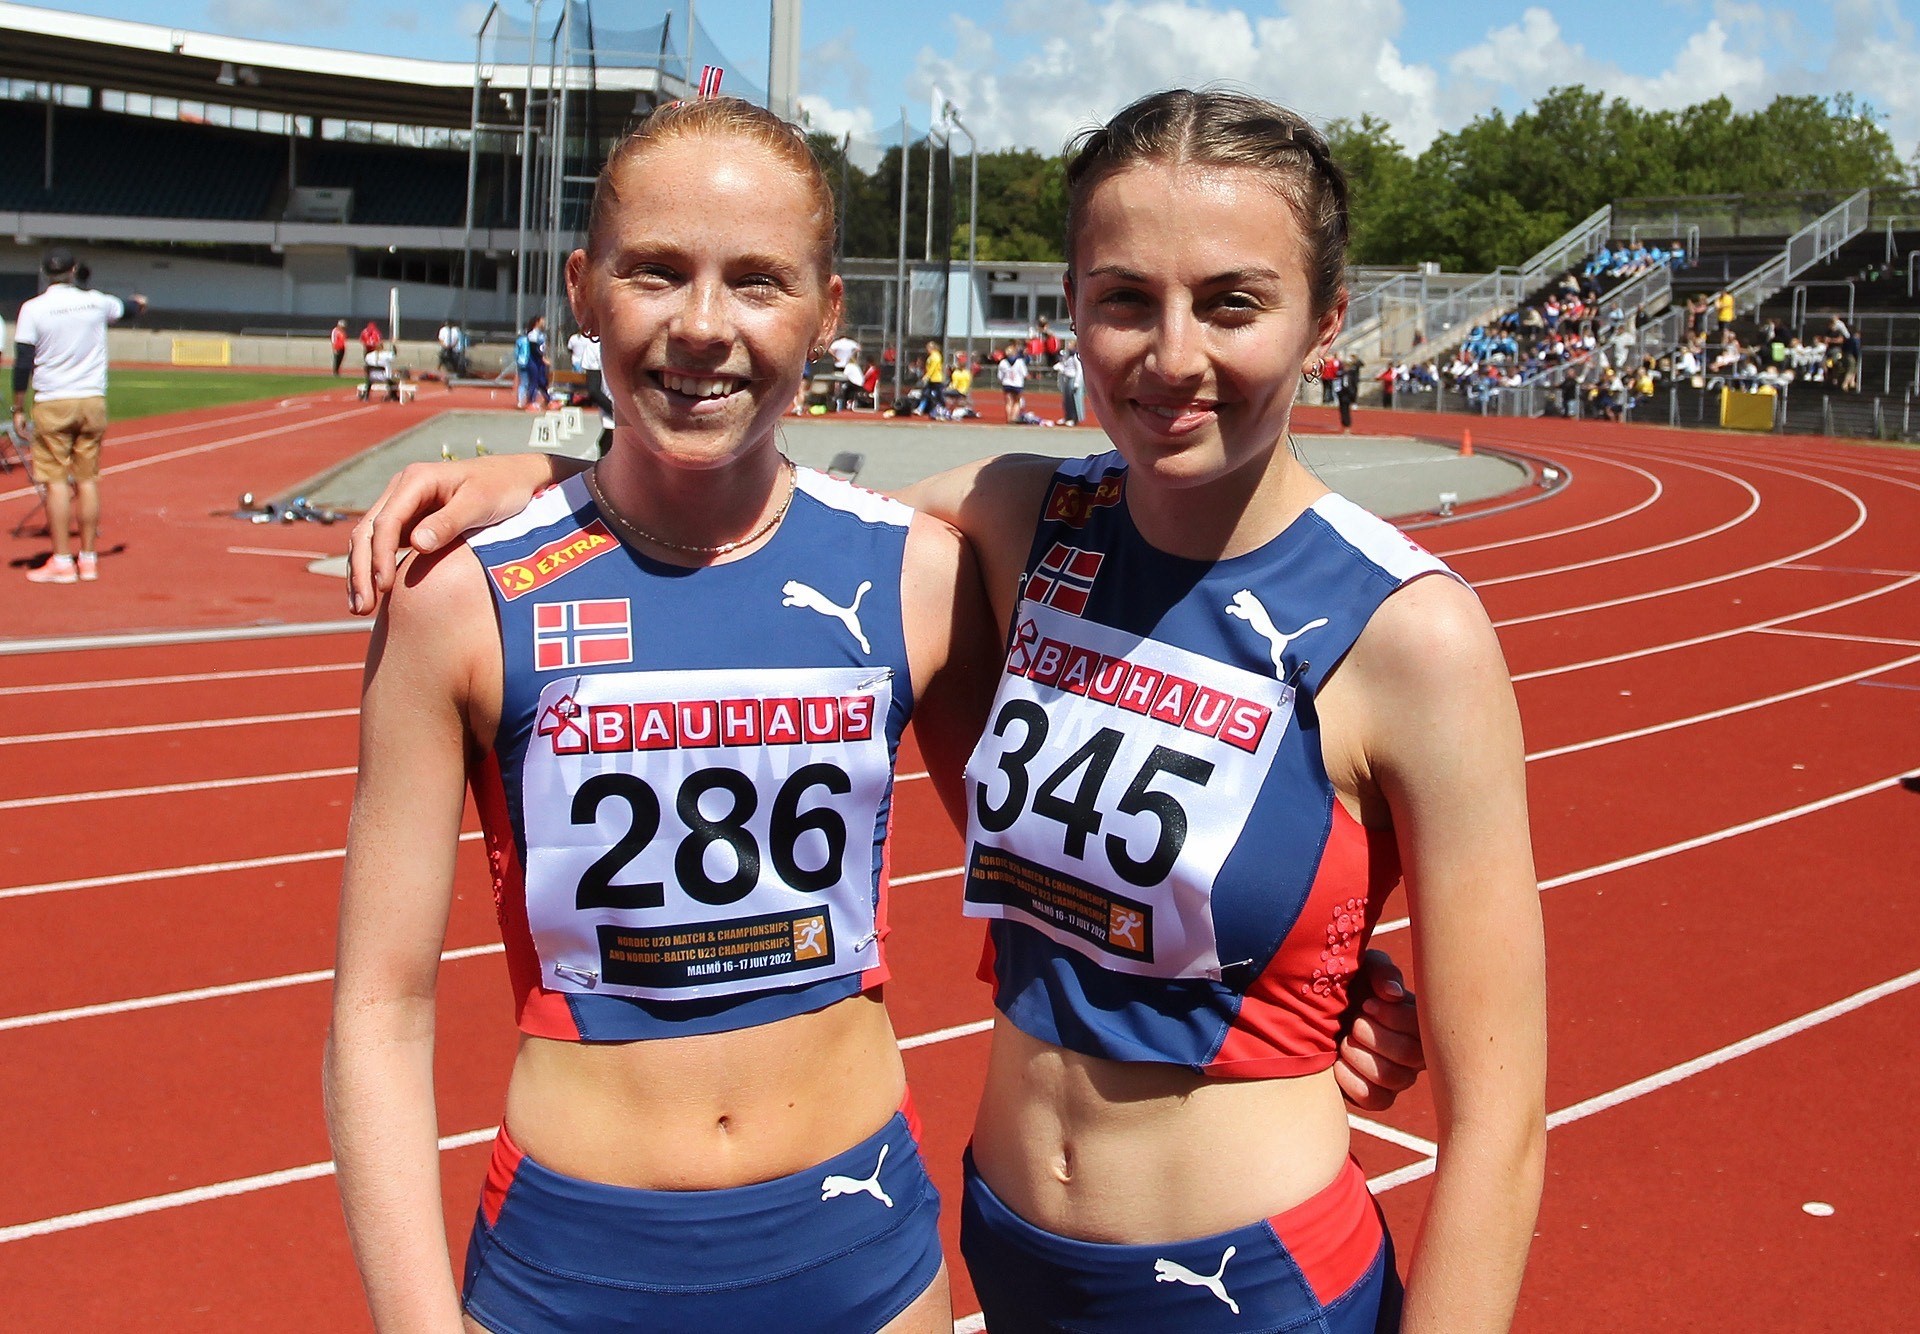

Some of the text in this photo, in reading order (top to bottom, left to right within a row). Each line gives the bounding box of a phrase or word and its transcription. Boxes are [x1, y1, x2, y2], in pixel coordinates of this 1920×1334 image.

[536, 534, 607, 575] EXTRA
[1034, 646, 1263, 741] BAUHAUS
[595, 702, 869, 744] BAUHAUS
[976, 698, 1175, 888] 345
[570, 762, 852, 911] 286
[972, 867, 986, 880] AND
[616, 921, 790, 948] NORDIC U20 MATCH & CHAMPIONSHIPS
[1090, 923, 1107, 941] 2022
[609, 937, 791, 963] AND NORDIC-BALTIC U23 CHAMPIONSHIPS
[687, 960, 722, 977] MALMÖ
[749, 955, 769, 969] JULY
[769, 952, 792, 966] 2022
